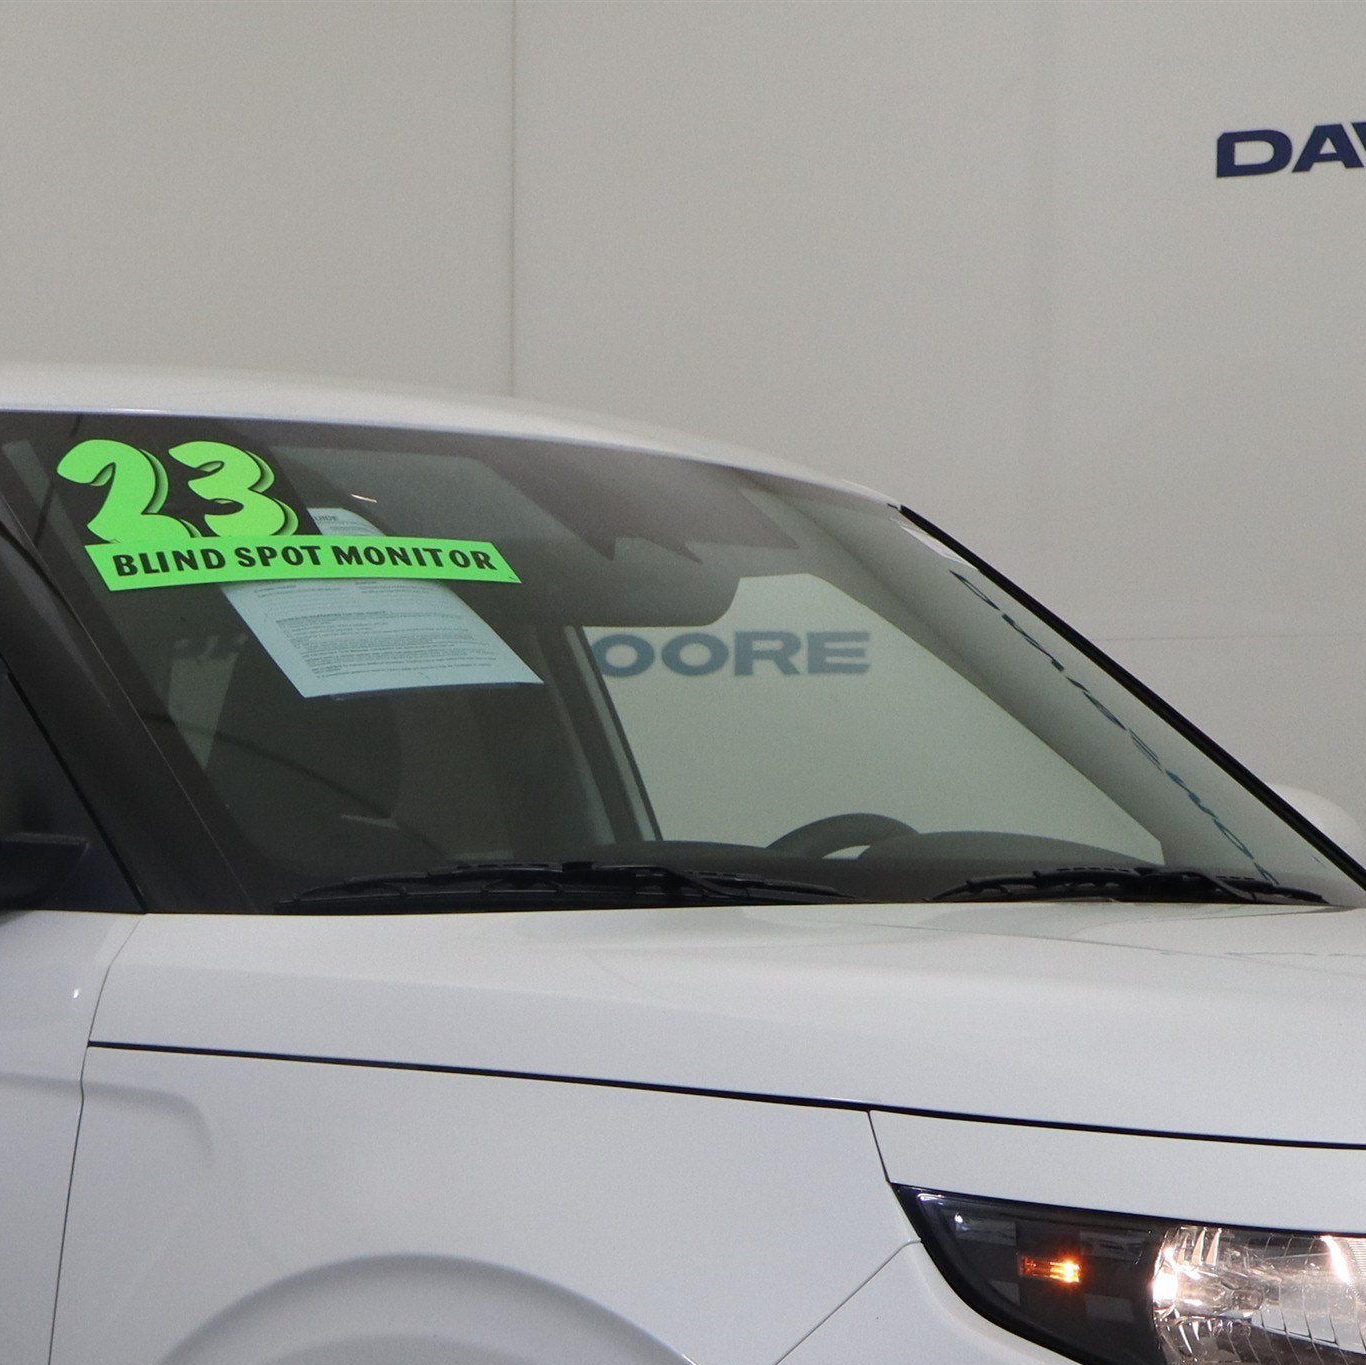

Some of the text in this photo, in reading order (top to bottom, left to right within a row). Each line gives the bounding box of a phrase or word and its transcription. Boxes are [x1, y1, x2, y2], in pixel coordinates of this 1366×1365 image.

[56, 439, 299, 545] 23
[112, 545, 498, 577] BLIND SPOT MONITOR
[591, 631, 870, 678] OORE
